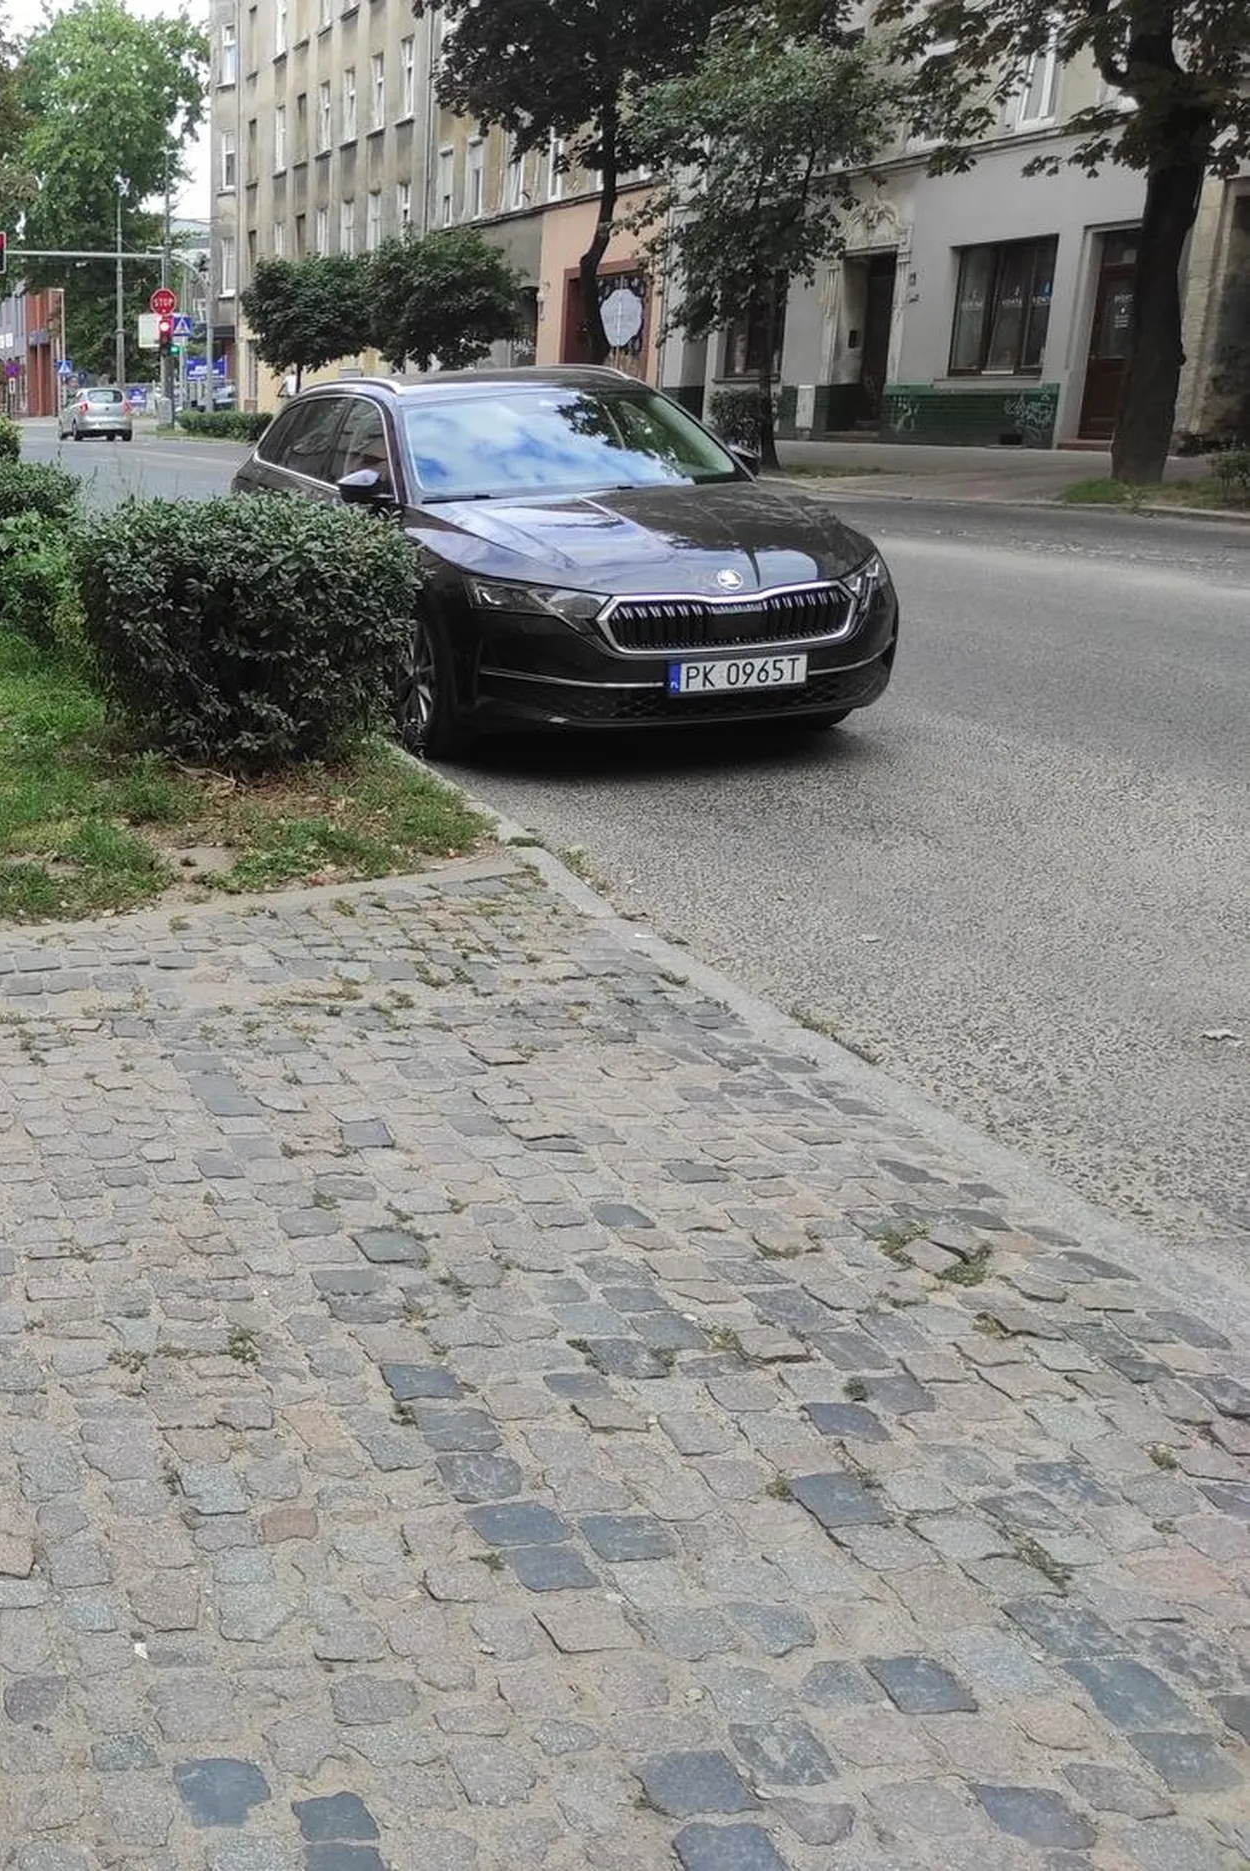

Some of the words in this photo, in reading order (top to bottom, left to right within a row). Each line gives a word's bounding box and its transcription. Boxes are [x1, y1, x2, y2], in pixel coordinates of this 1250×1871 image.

[154, 298, 173, 307] STOP
[685, 665, 716, 689] PK
[726, 658, 800, 686] 0965T
